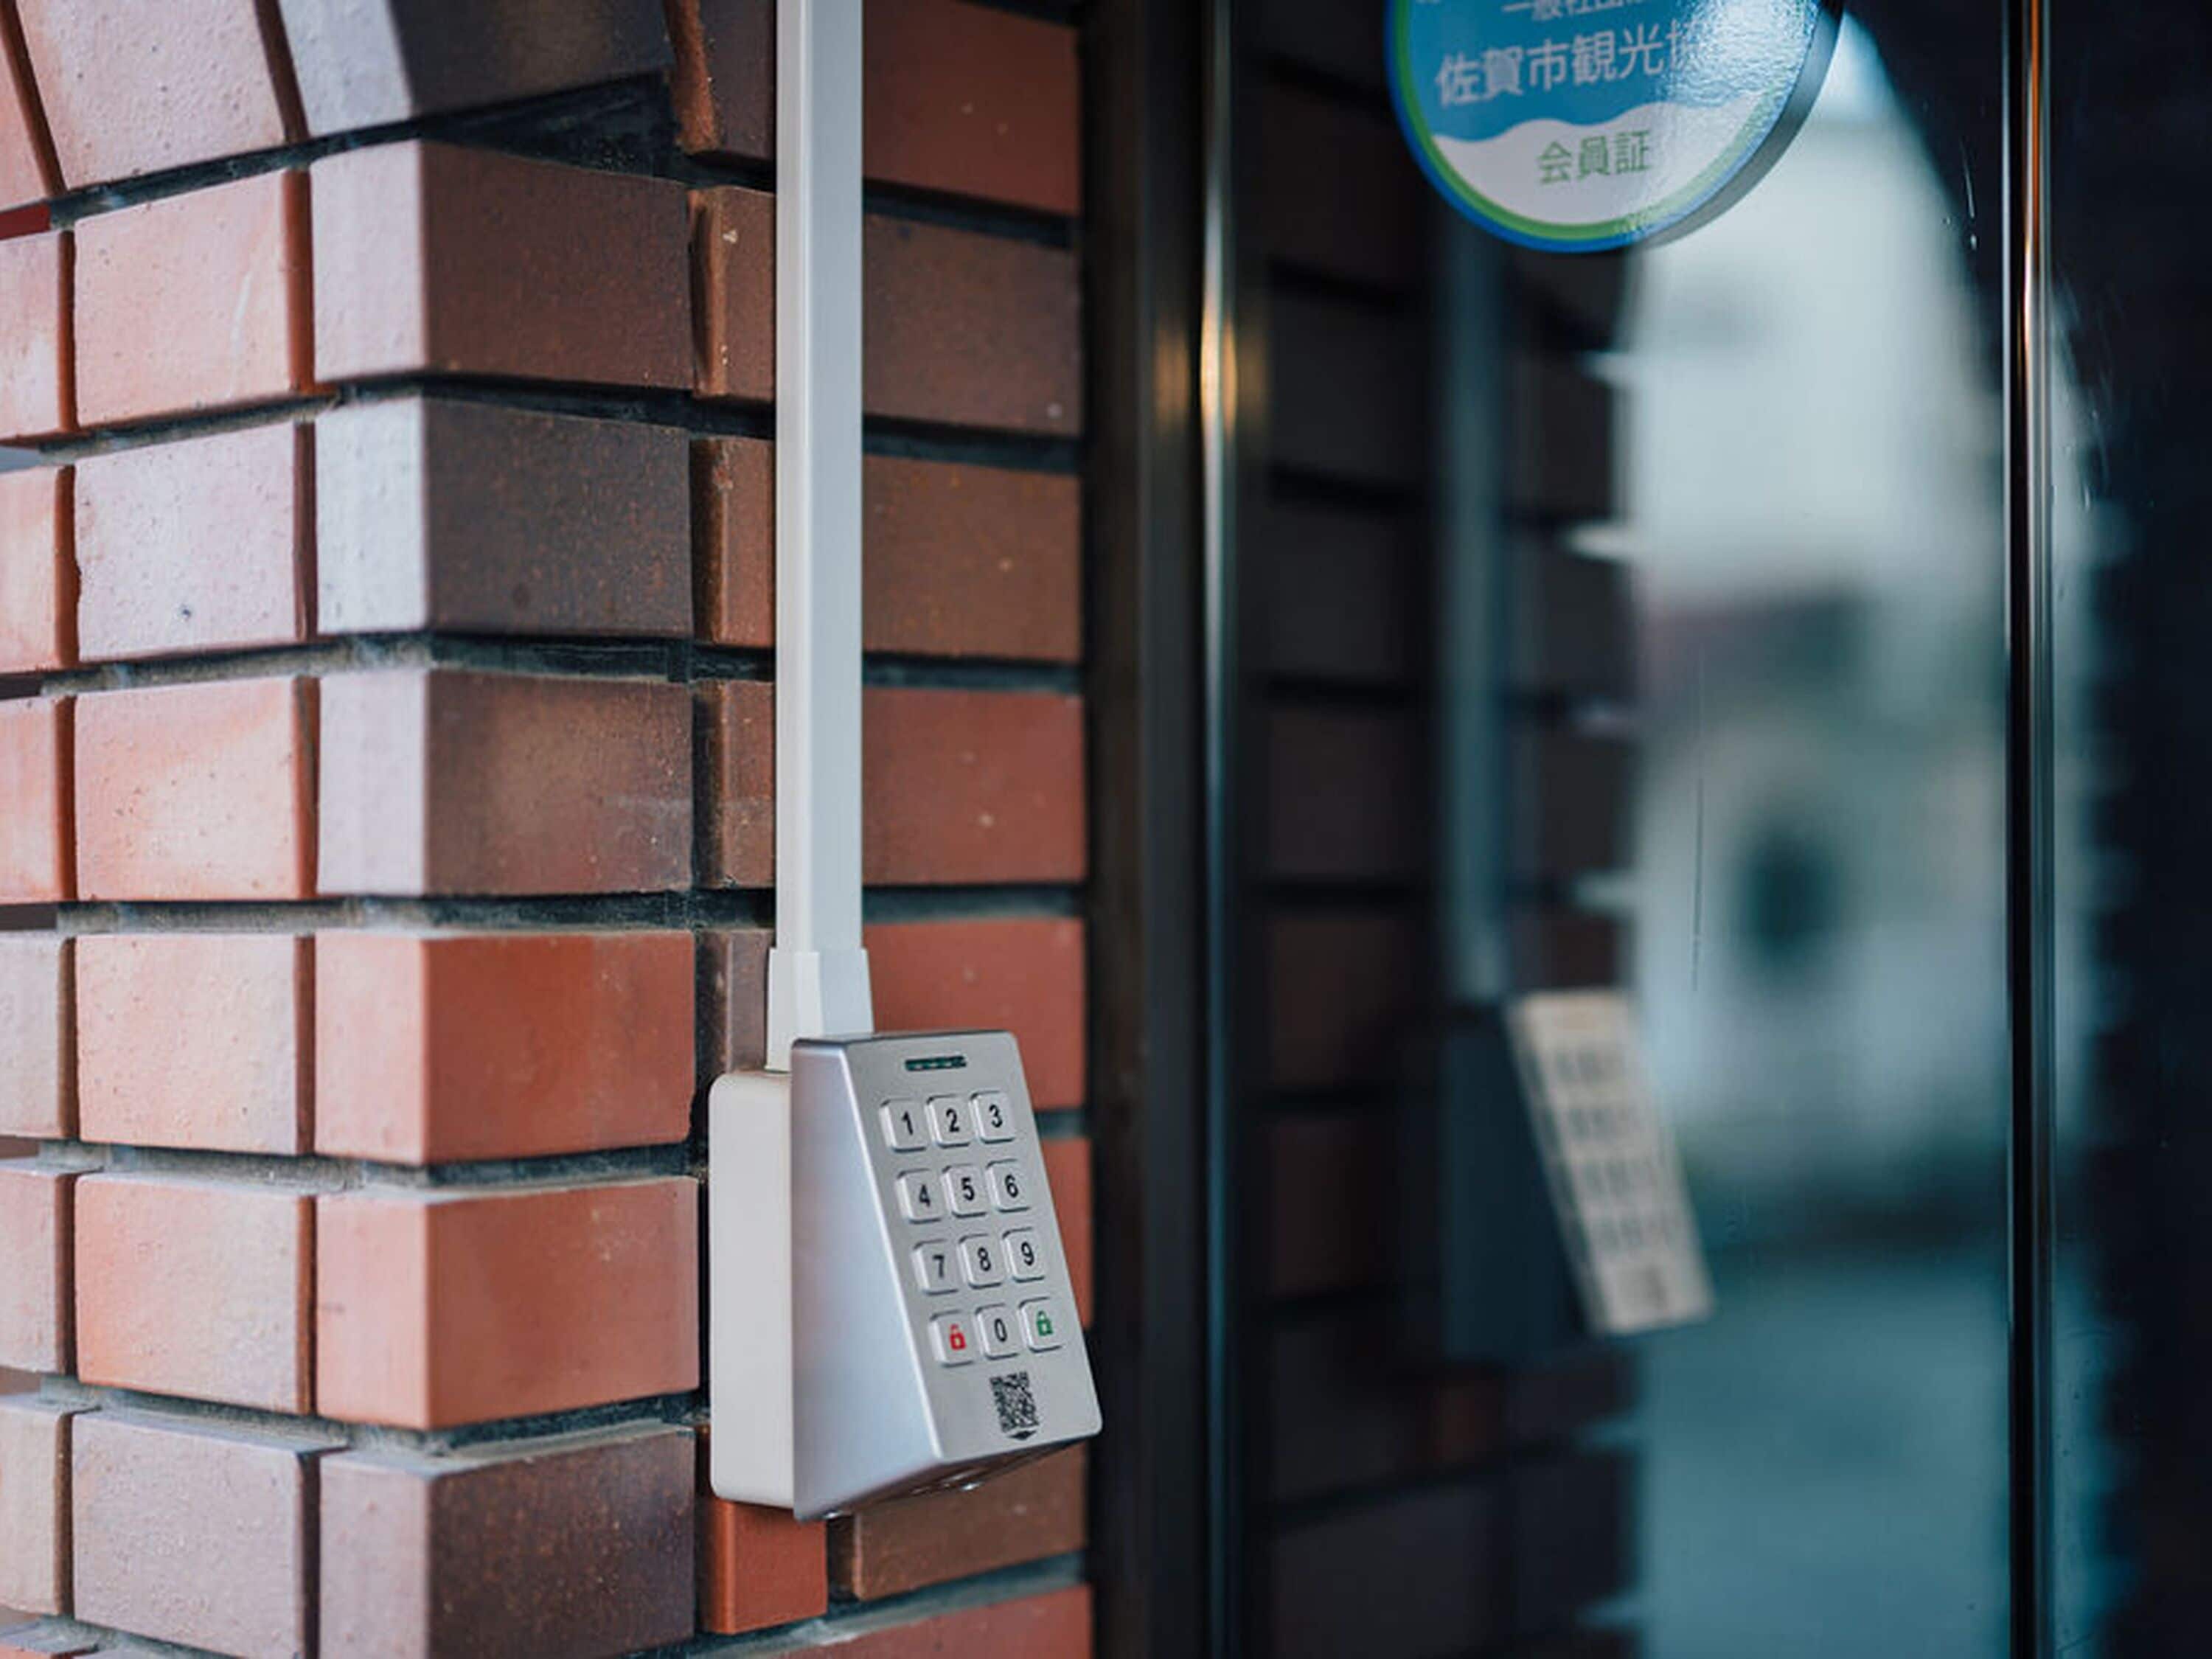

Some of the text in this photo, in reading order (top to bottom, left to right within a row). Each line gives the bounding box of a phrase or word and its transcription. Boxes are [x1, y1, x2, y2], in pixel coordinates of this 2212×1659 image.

[1537, 129, 1652, 184] 会員証
[901, 1104, 1003, 1135] 1 2 3
[919, 1173, 1019, 1208] 4 5 6
[932, 1241, 1035, 1279] 7 8 9
[993, 1318, 1008, 1343] 0
